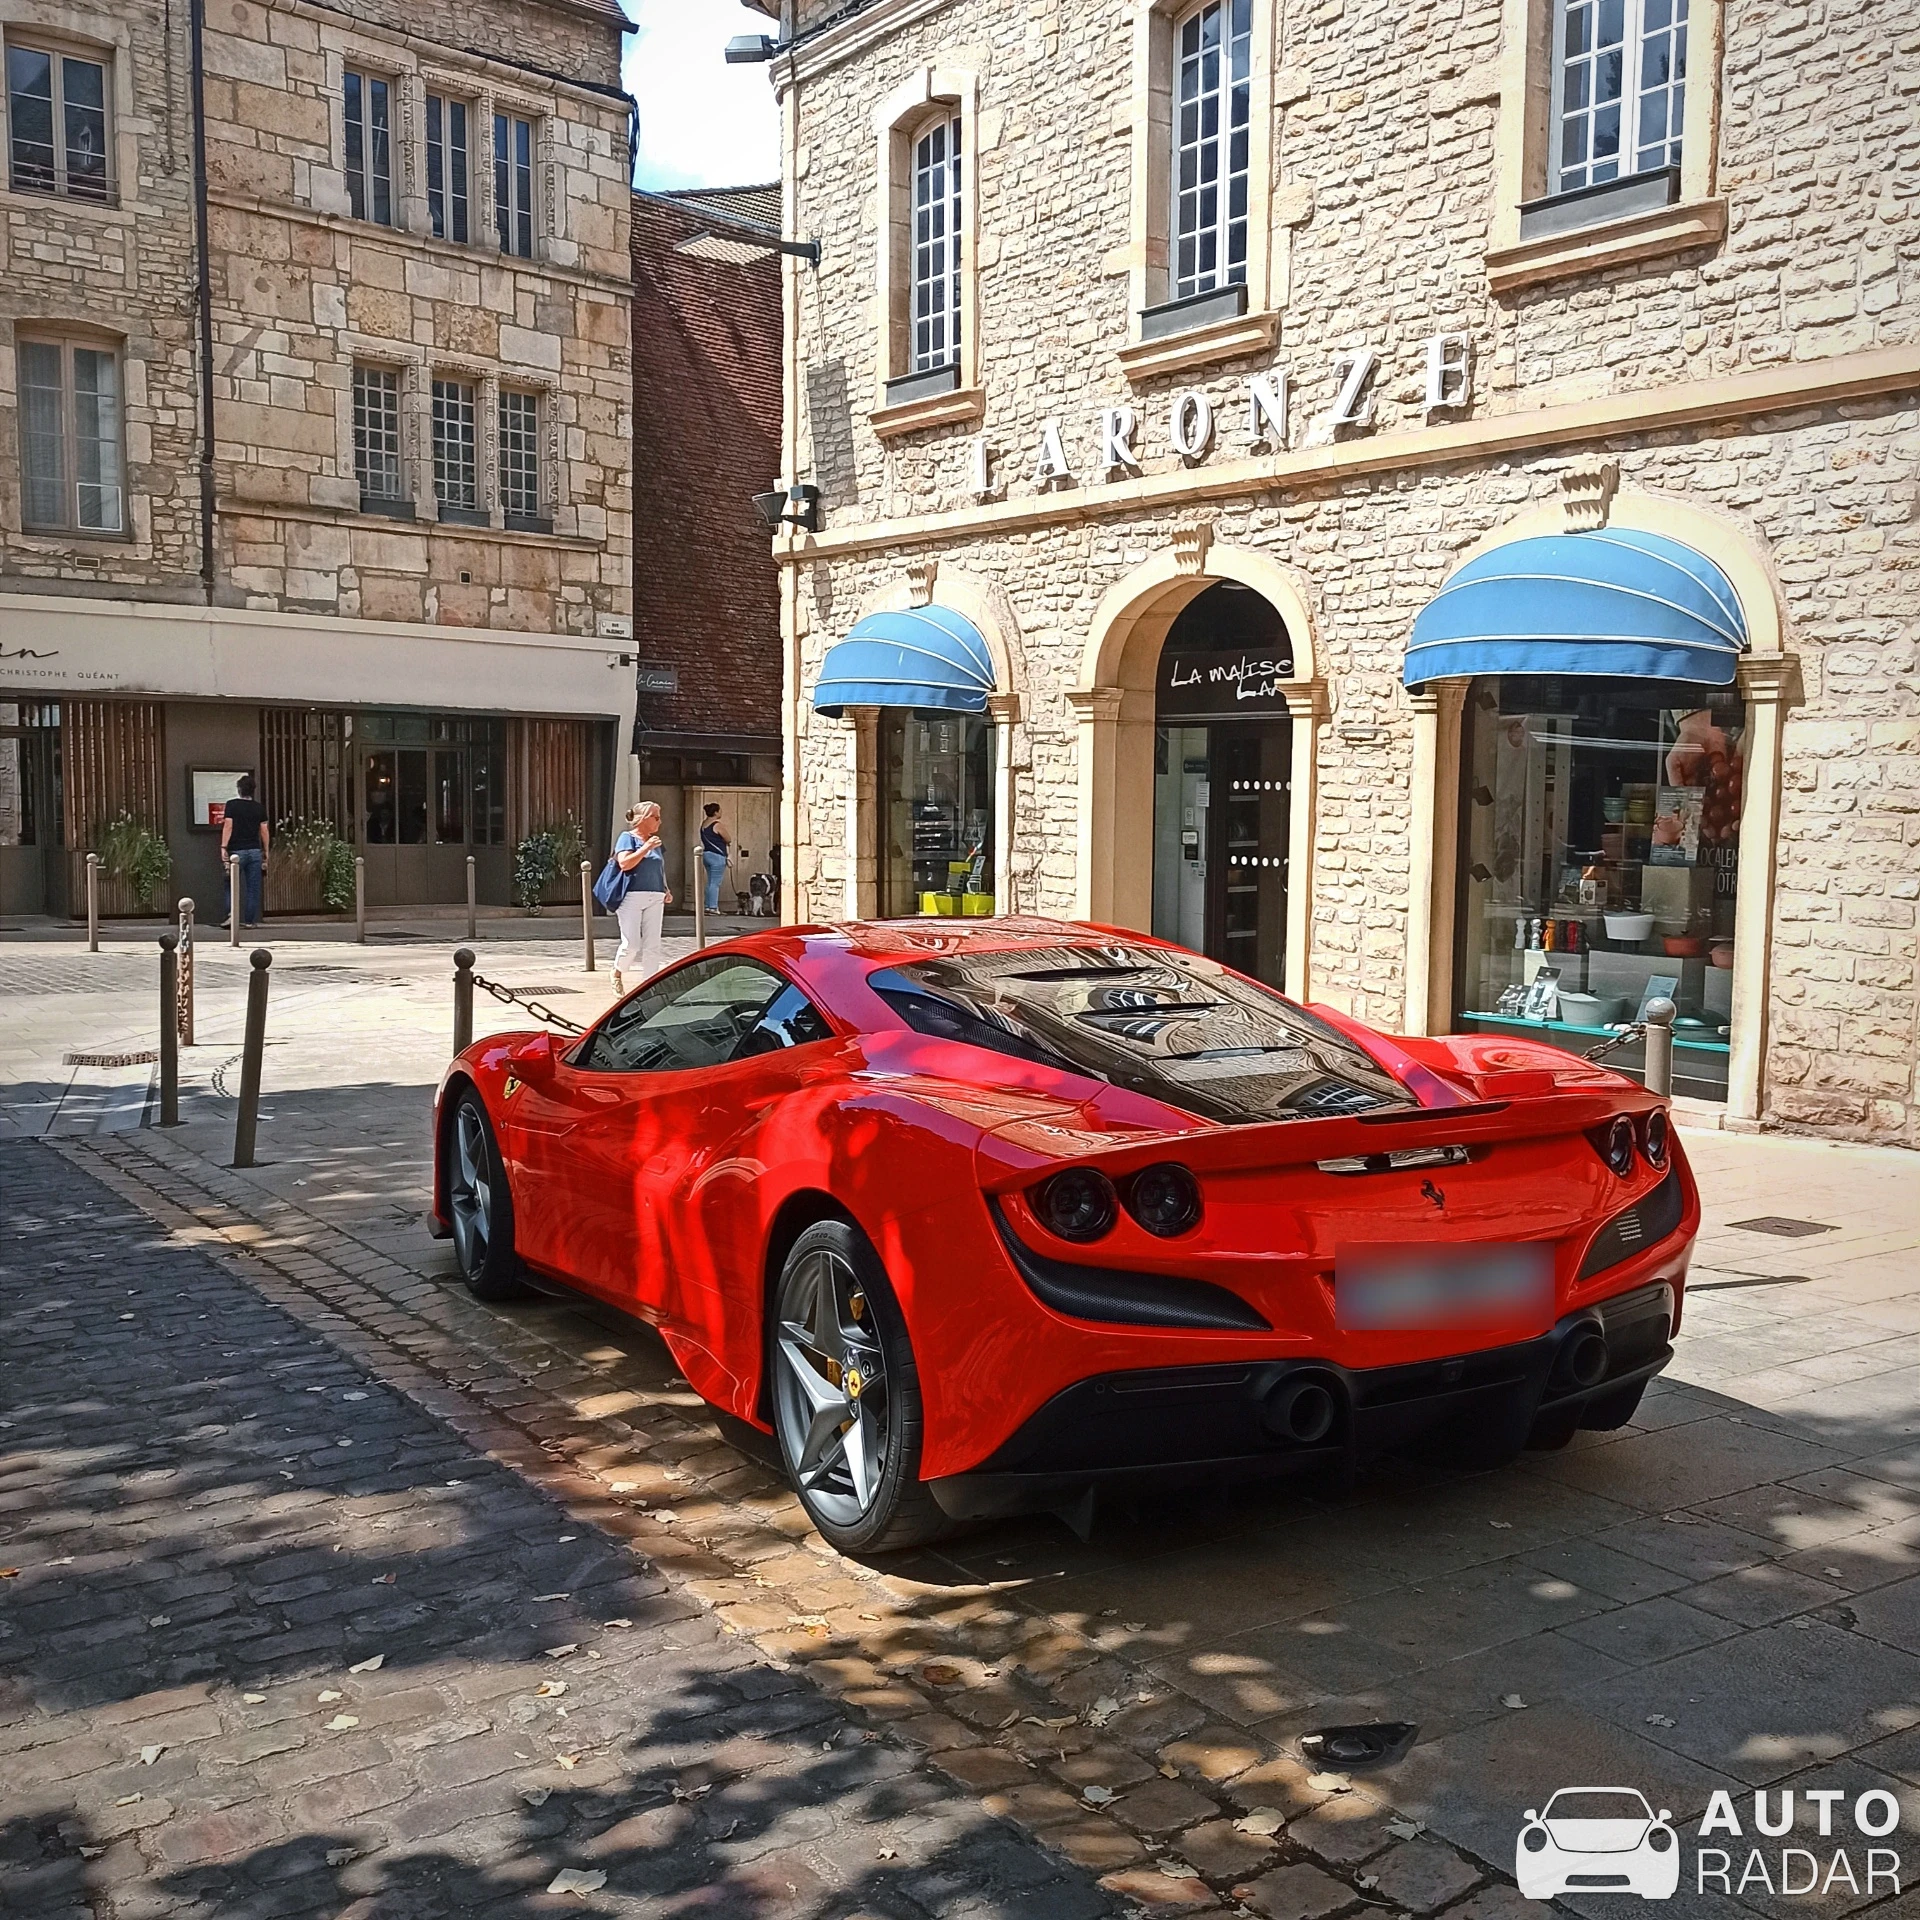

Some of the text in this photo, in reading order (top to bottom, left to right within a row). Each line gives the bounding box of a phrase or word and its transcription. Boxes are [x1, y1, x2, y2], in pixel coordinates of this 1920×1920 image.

[972, 331, 1473, 494] LARONZE
[0, 668, 120, 680] CHRISTOPHE QUÉANT
[1171, 660, 1202, 687] LA
